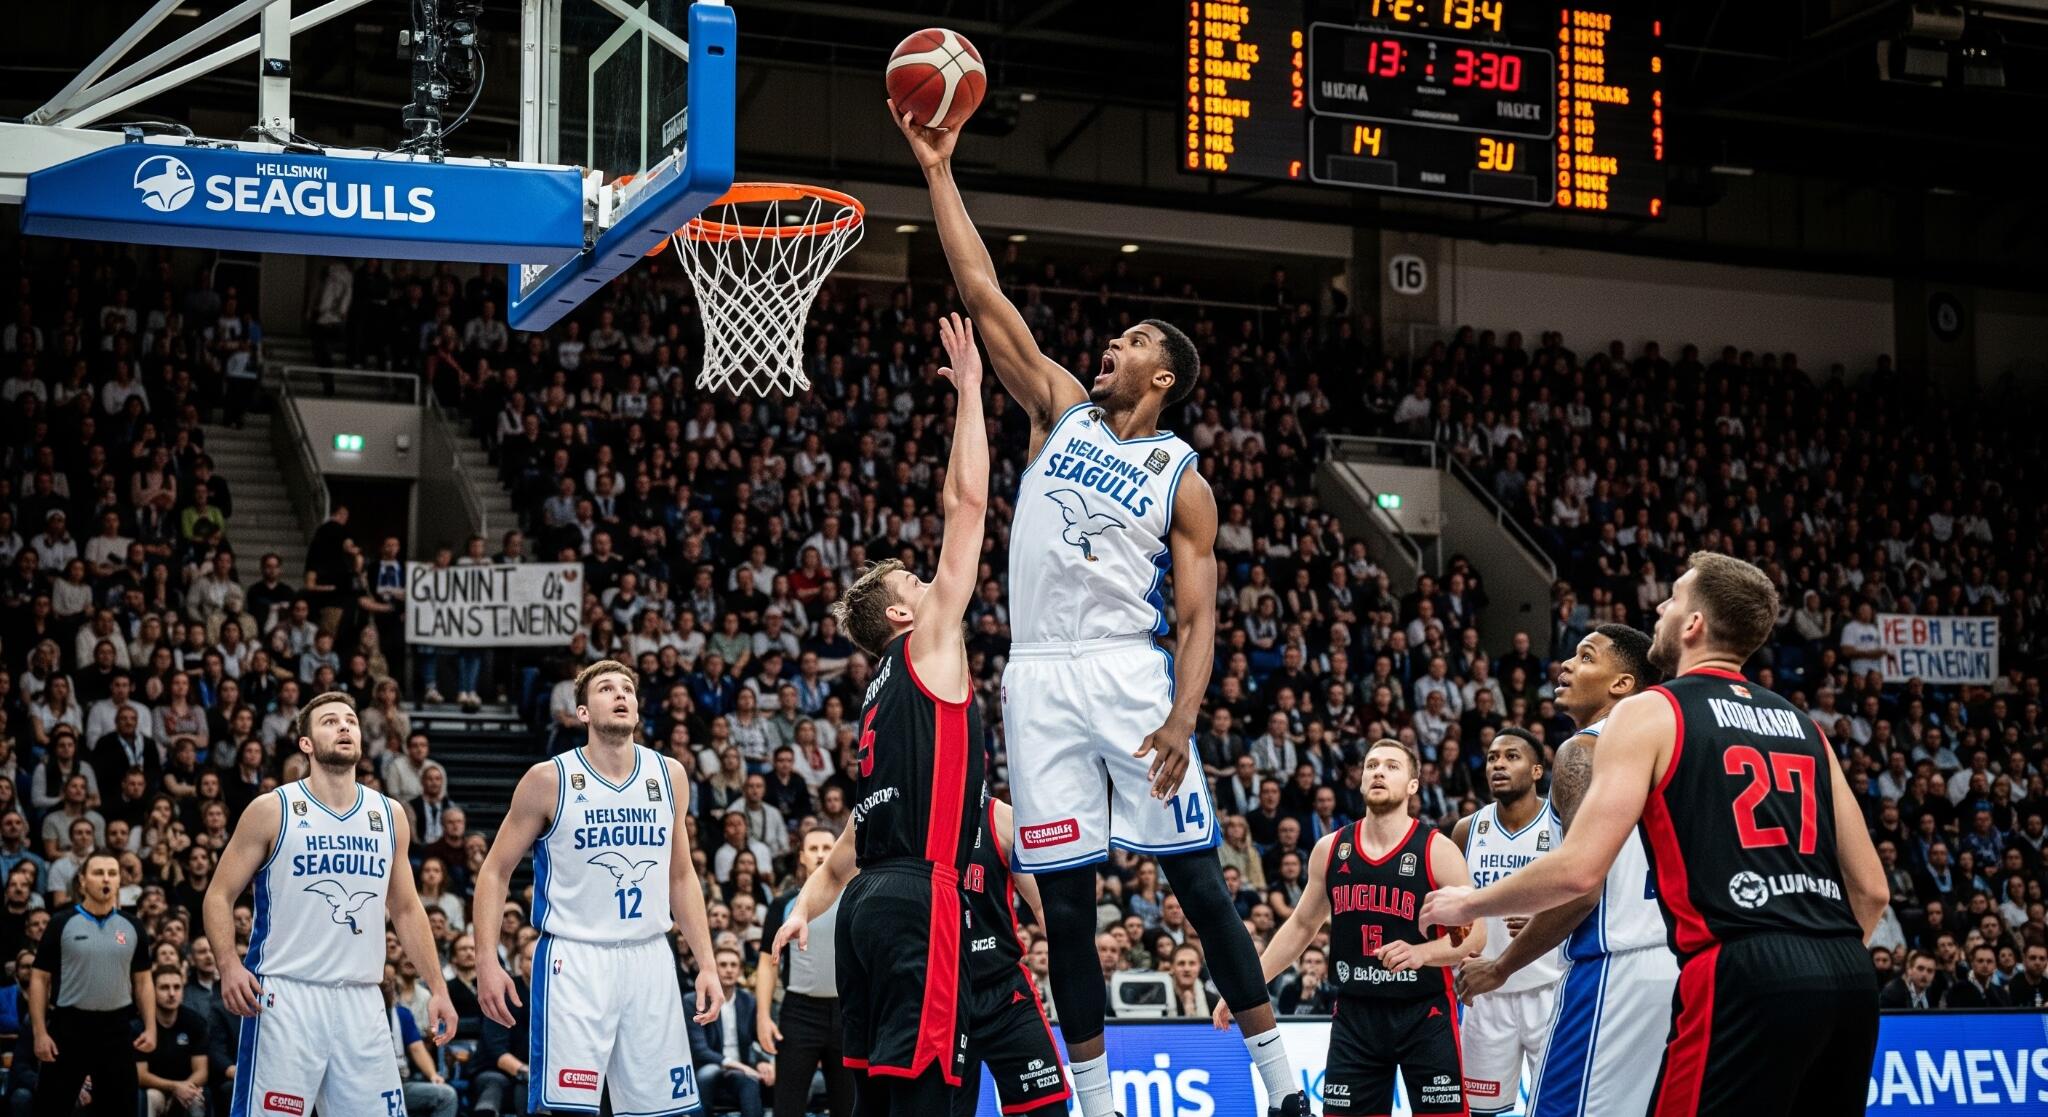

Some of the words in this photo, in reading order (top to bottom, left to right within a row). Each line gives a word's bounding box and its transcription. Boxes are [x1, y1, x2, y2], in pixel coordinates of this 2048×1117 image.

[1451, 49, 1522, 92] 3:30
[1352, 125, 1382, 157] 14
[205, 174, 436, 224] SEAGULLS
[1394, 260, 1422, 288] 16
[1044, 453, 1154, 518] SEAGULLS
[1167, 792, 1205, 834] 14
[1723, 745, 1818, 855] 27
[306, 835, 379, 853] HELSINKI
[574, 826, 667, 850] SEAGULLS
[292, 853, 386, 879] SEAGULLS
[614, 887, 643, 920] 12
